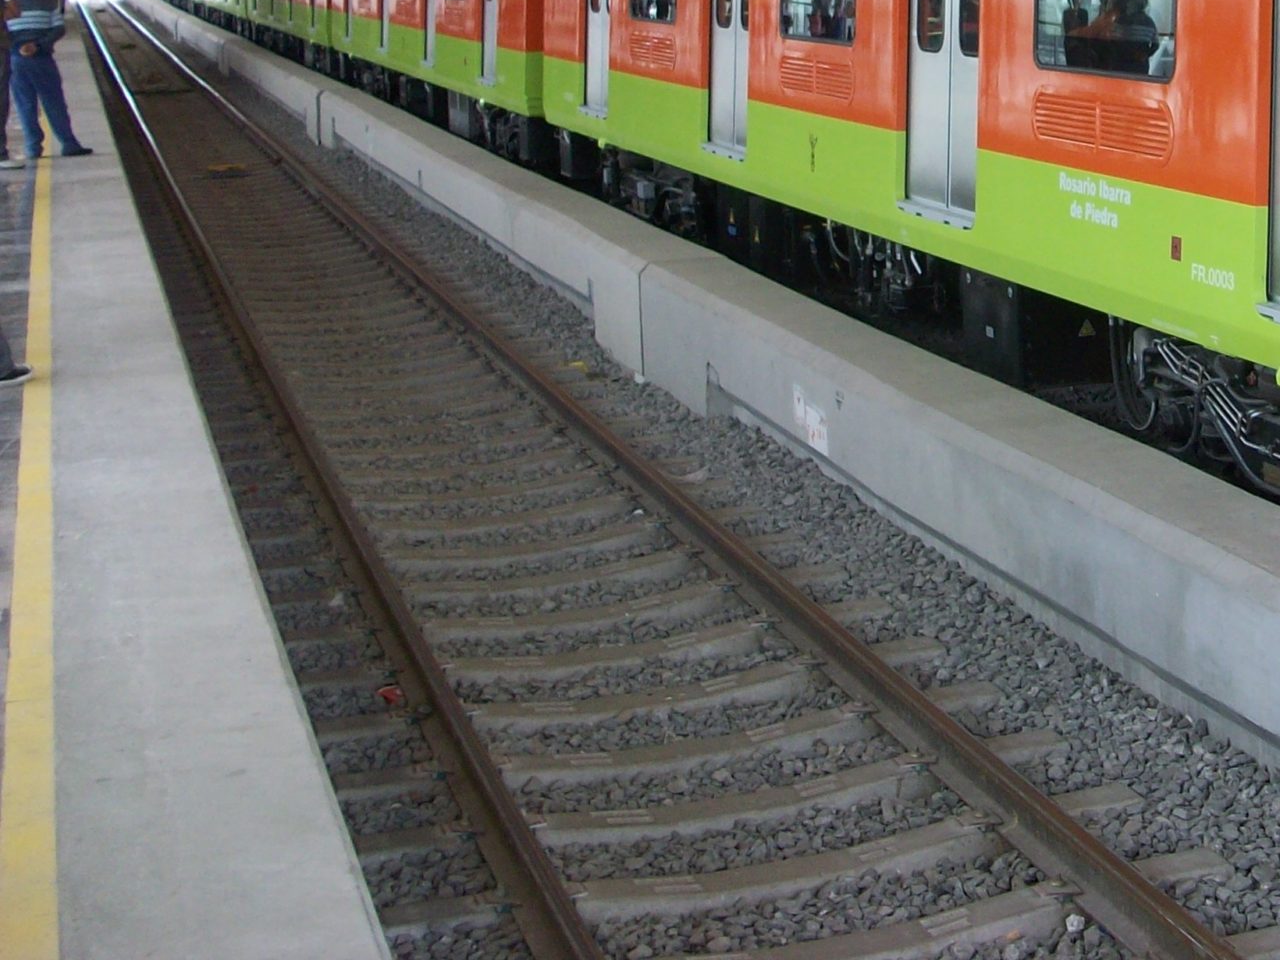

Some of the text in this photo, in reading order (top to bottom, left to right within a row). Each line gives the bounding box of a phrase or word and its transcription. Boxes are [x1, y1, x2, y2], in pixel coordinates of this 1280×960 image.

[1059, 171, 1131, 206] Rosario Ibarra
[1070, 200, 1118, 229] de Piedra
[1191, 262, 1234, 291] FR.0003
